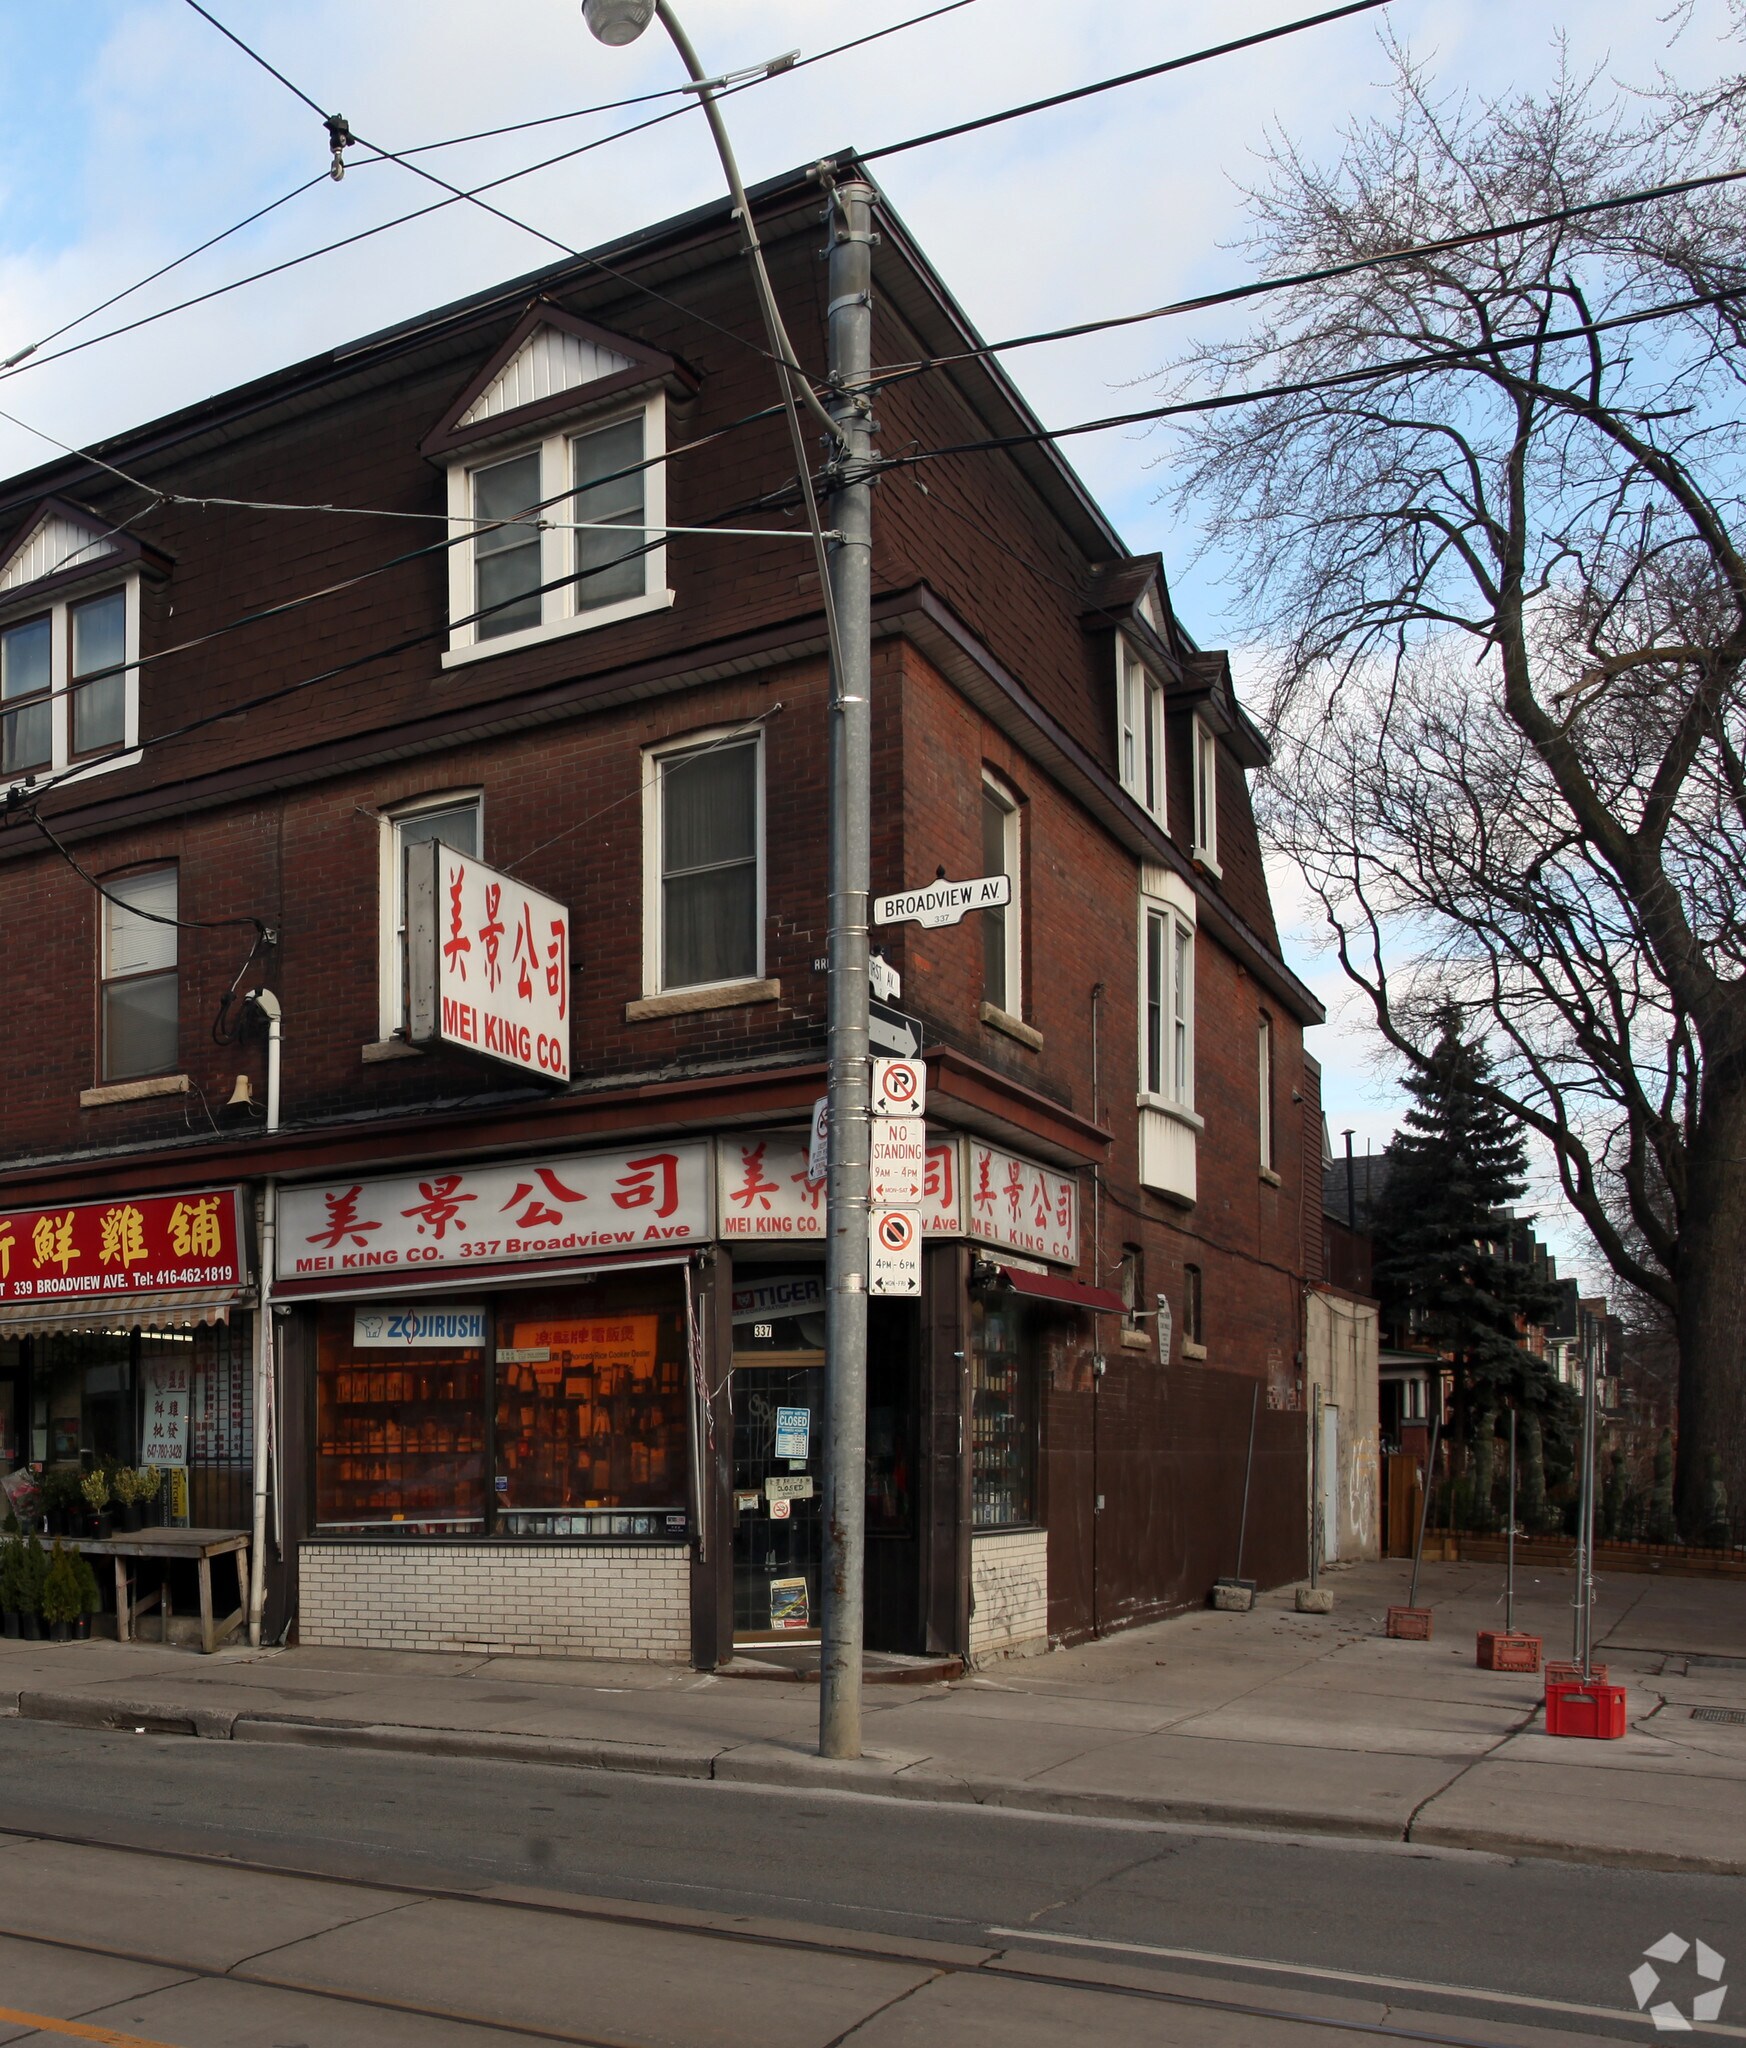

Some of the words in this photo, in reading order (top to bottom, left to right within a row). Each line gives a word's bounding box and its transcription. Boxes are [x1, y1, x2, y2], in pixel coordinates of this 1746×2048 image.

[885, 886, 972, 918] BROADVIEW
[980, 881, 1000, 901] AV.
[934, 914, 950, 923] 337
[443, 863, 566, 1021] 美景公司
[443, 996, 478, 1044] MEI
[484, 1012, 531, 1063] KING
[537, 1033, 567, 1076] CO.
[889, 1126, 907, 1141] NO
[874, 1143, 922, 1160] STANDING
[875, 1166, 891, 1177] 9AM
[901, 1166, 918, 1177] 4PM
[305, 1153, 680, 1250] 美景公司
[972, 1149, 1073, 1241] 美景公司
[725, 1217, 751, 1233] MEI
[755, 1216, 792, 1232] KING
[796, 1216, 821, 1232] CO.
[932, 1217, 957, 1231] Ave
[296, 1257, 334, 1273] MEI
[342, 1249, 399, 1269] KING
[406, 1246, 445, 1262] CO.
[459, 1240, 501, 1258] 337
[505, 1229, 635, 1254] Broadview
[642, 1223, 691, 1241] Ave
[970, 1217, 998, 1238] MEI
[1009, 1231, 1045, 1252] KING
[1053, 1241, 1075, 1260] CO.
[875, 1258, 892, 1270] 4PM
[899, 1259, 915, 1270] 6PM
[14, 1279, 33, 1295] 339
[36, 1275, 101, 1294] BROADVIEW
[103, 1273, 128, 1288] AVE.
[133, 1271, 154, 1287] Tel:
[156, 1265, 232, 1285] 416-462-1819
[754, 1280, 820, 1307] TIGER
[387, 1314, 488, 1338] ZOJIRUSHI
[754, 1325, 772, 1337] 337
[779, 1415, 808, 1427] CLOSED
[172, 1471, 180, 1514] FLETCHER
